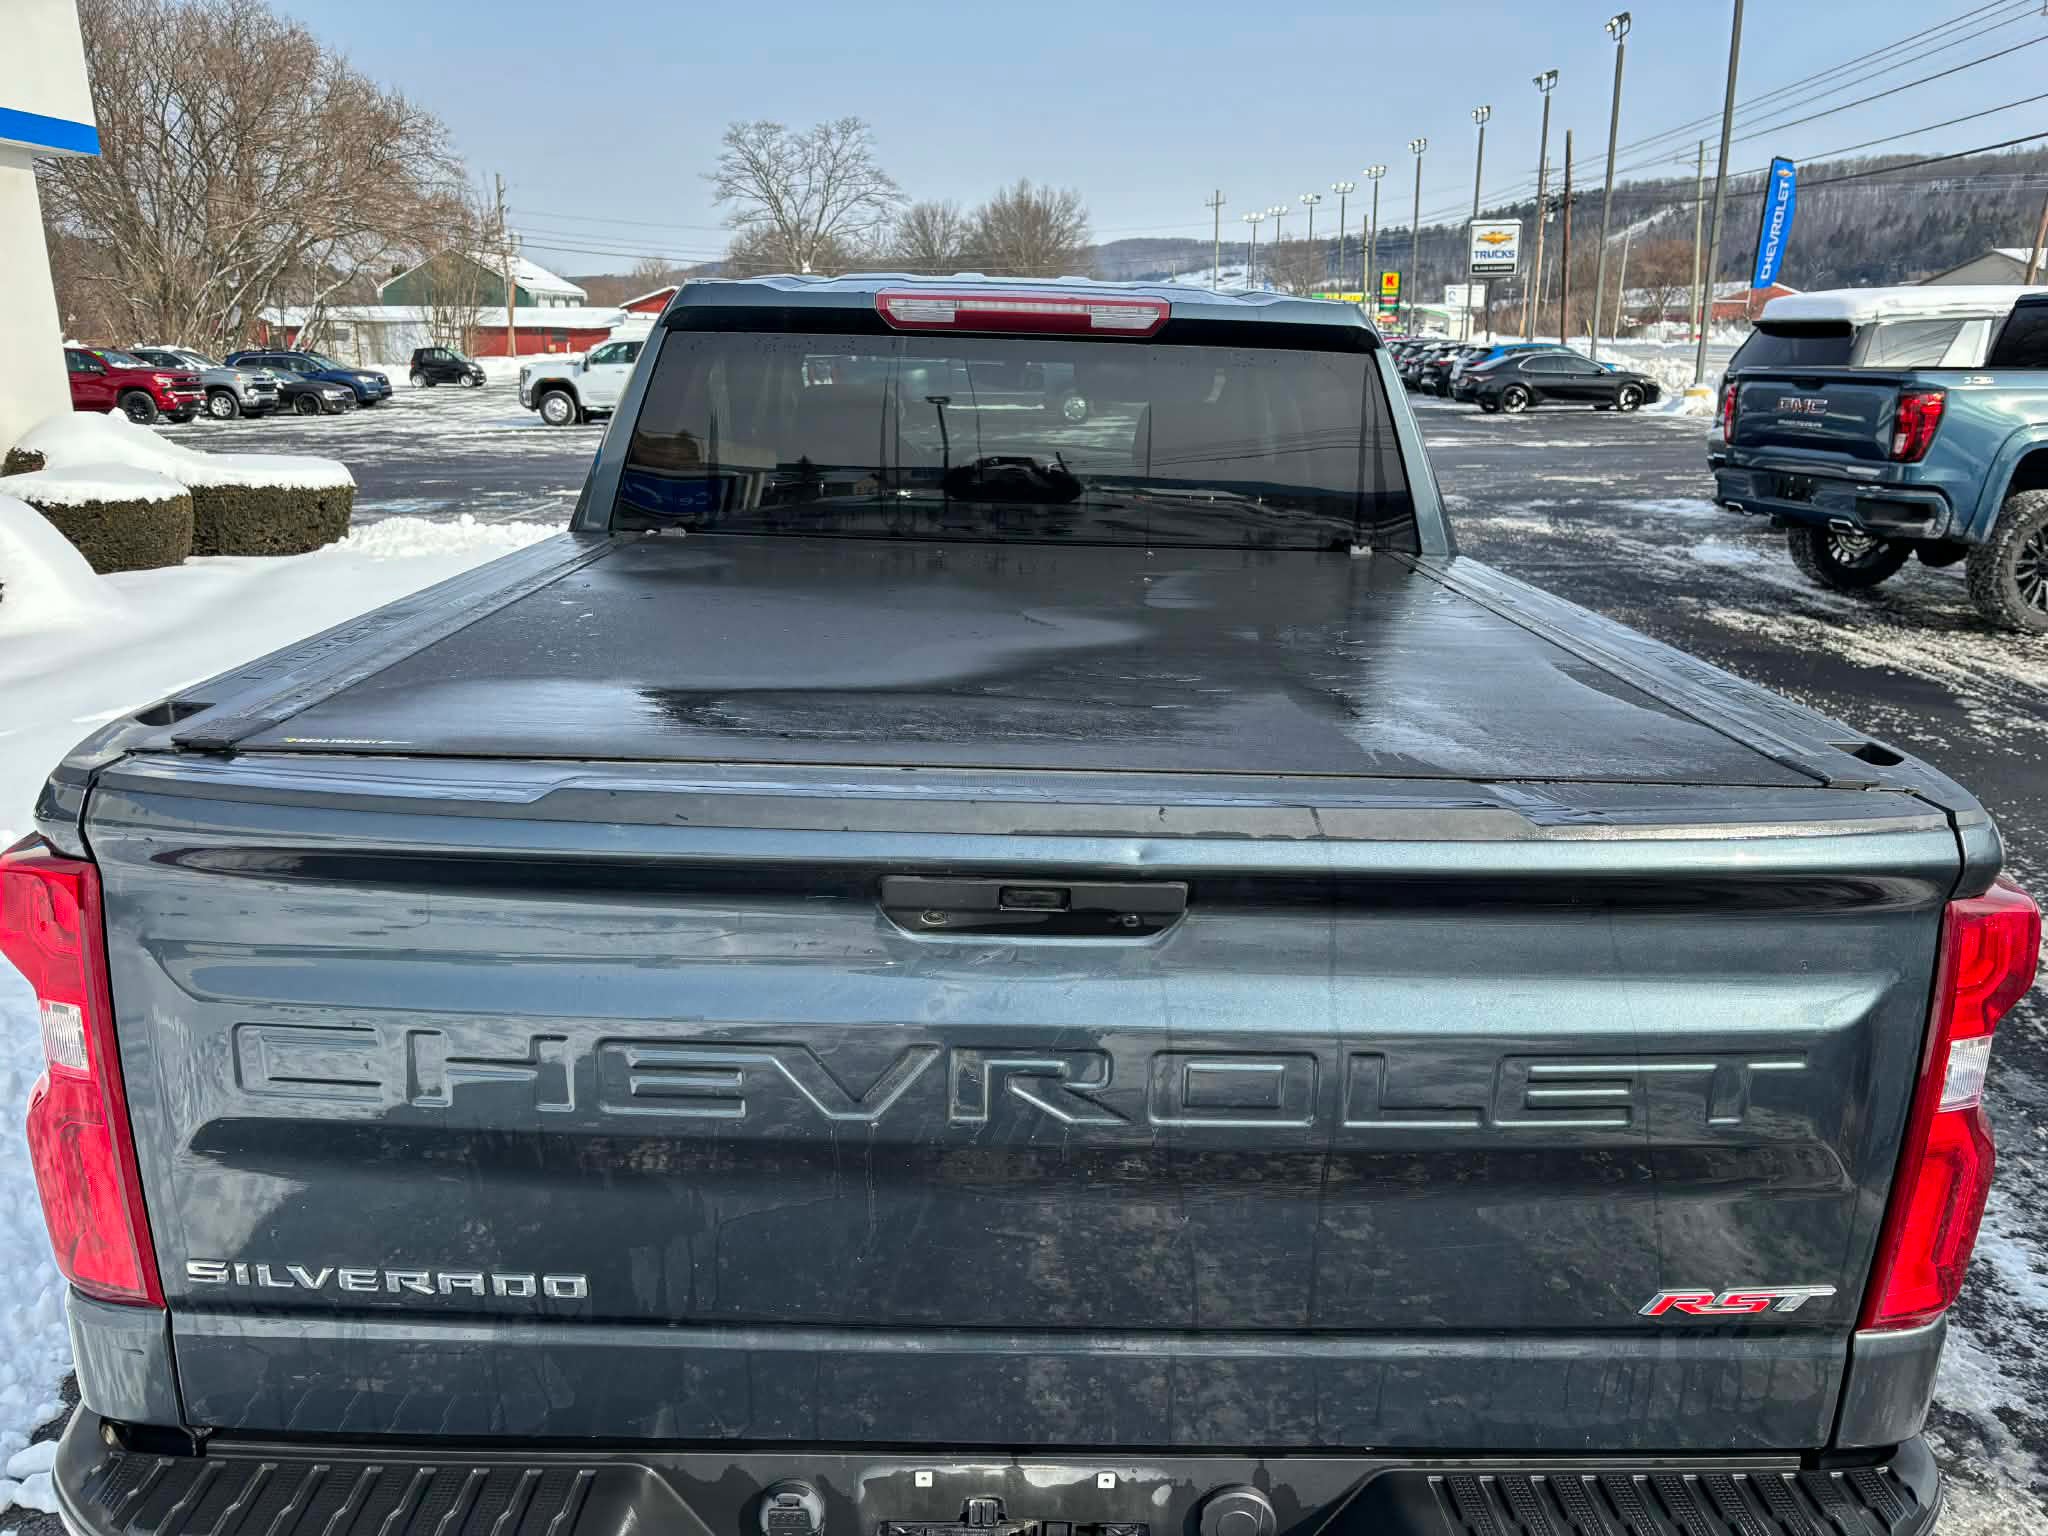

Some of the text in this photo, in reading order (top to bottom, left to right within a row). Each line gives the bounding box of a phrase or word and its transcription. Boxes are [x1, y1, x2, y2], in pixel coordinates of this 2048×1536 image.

[1760, 179, 1790, 281] CHEVROLET
[1474, 250, 1515, 259] TRUCKS
[231, 1022, 1808, 1130] CHEVROLET
[185, 1257, 590, 1299] SILVERADO
[1637, 1284, 1838, 1316] RST
